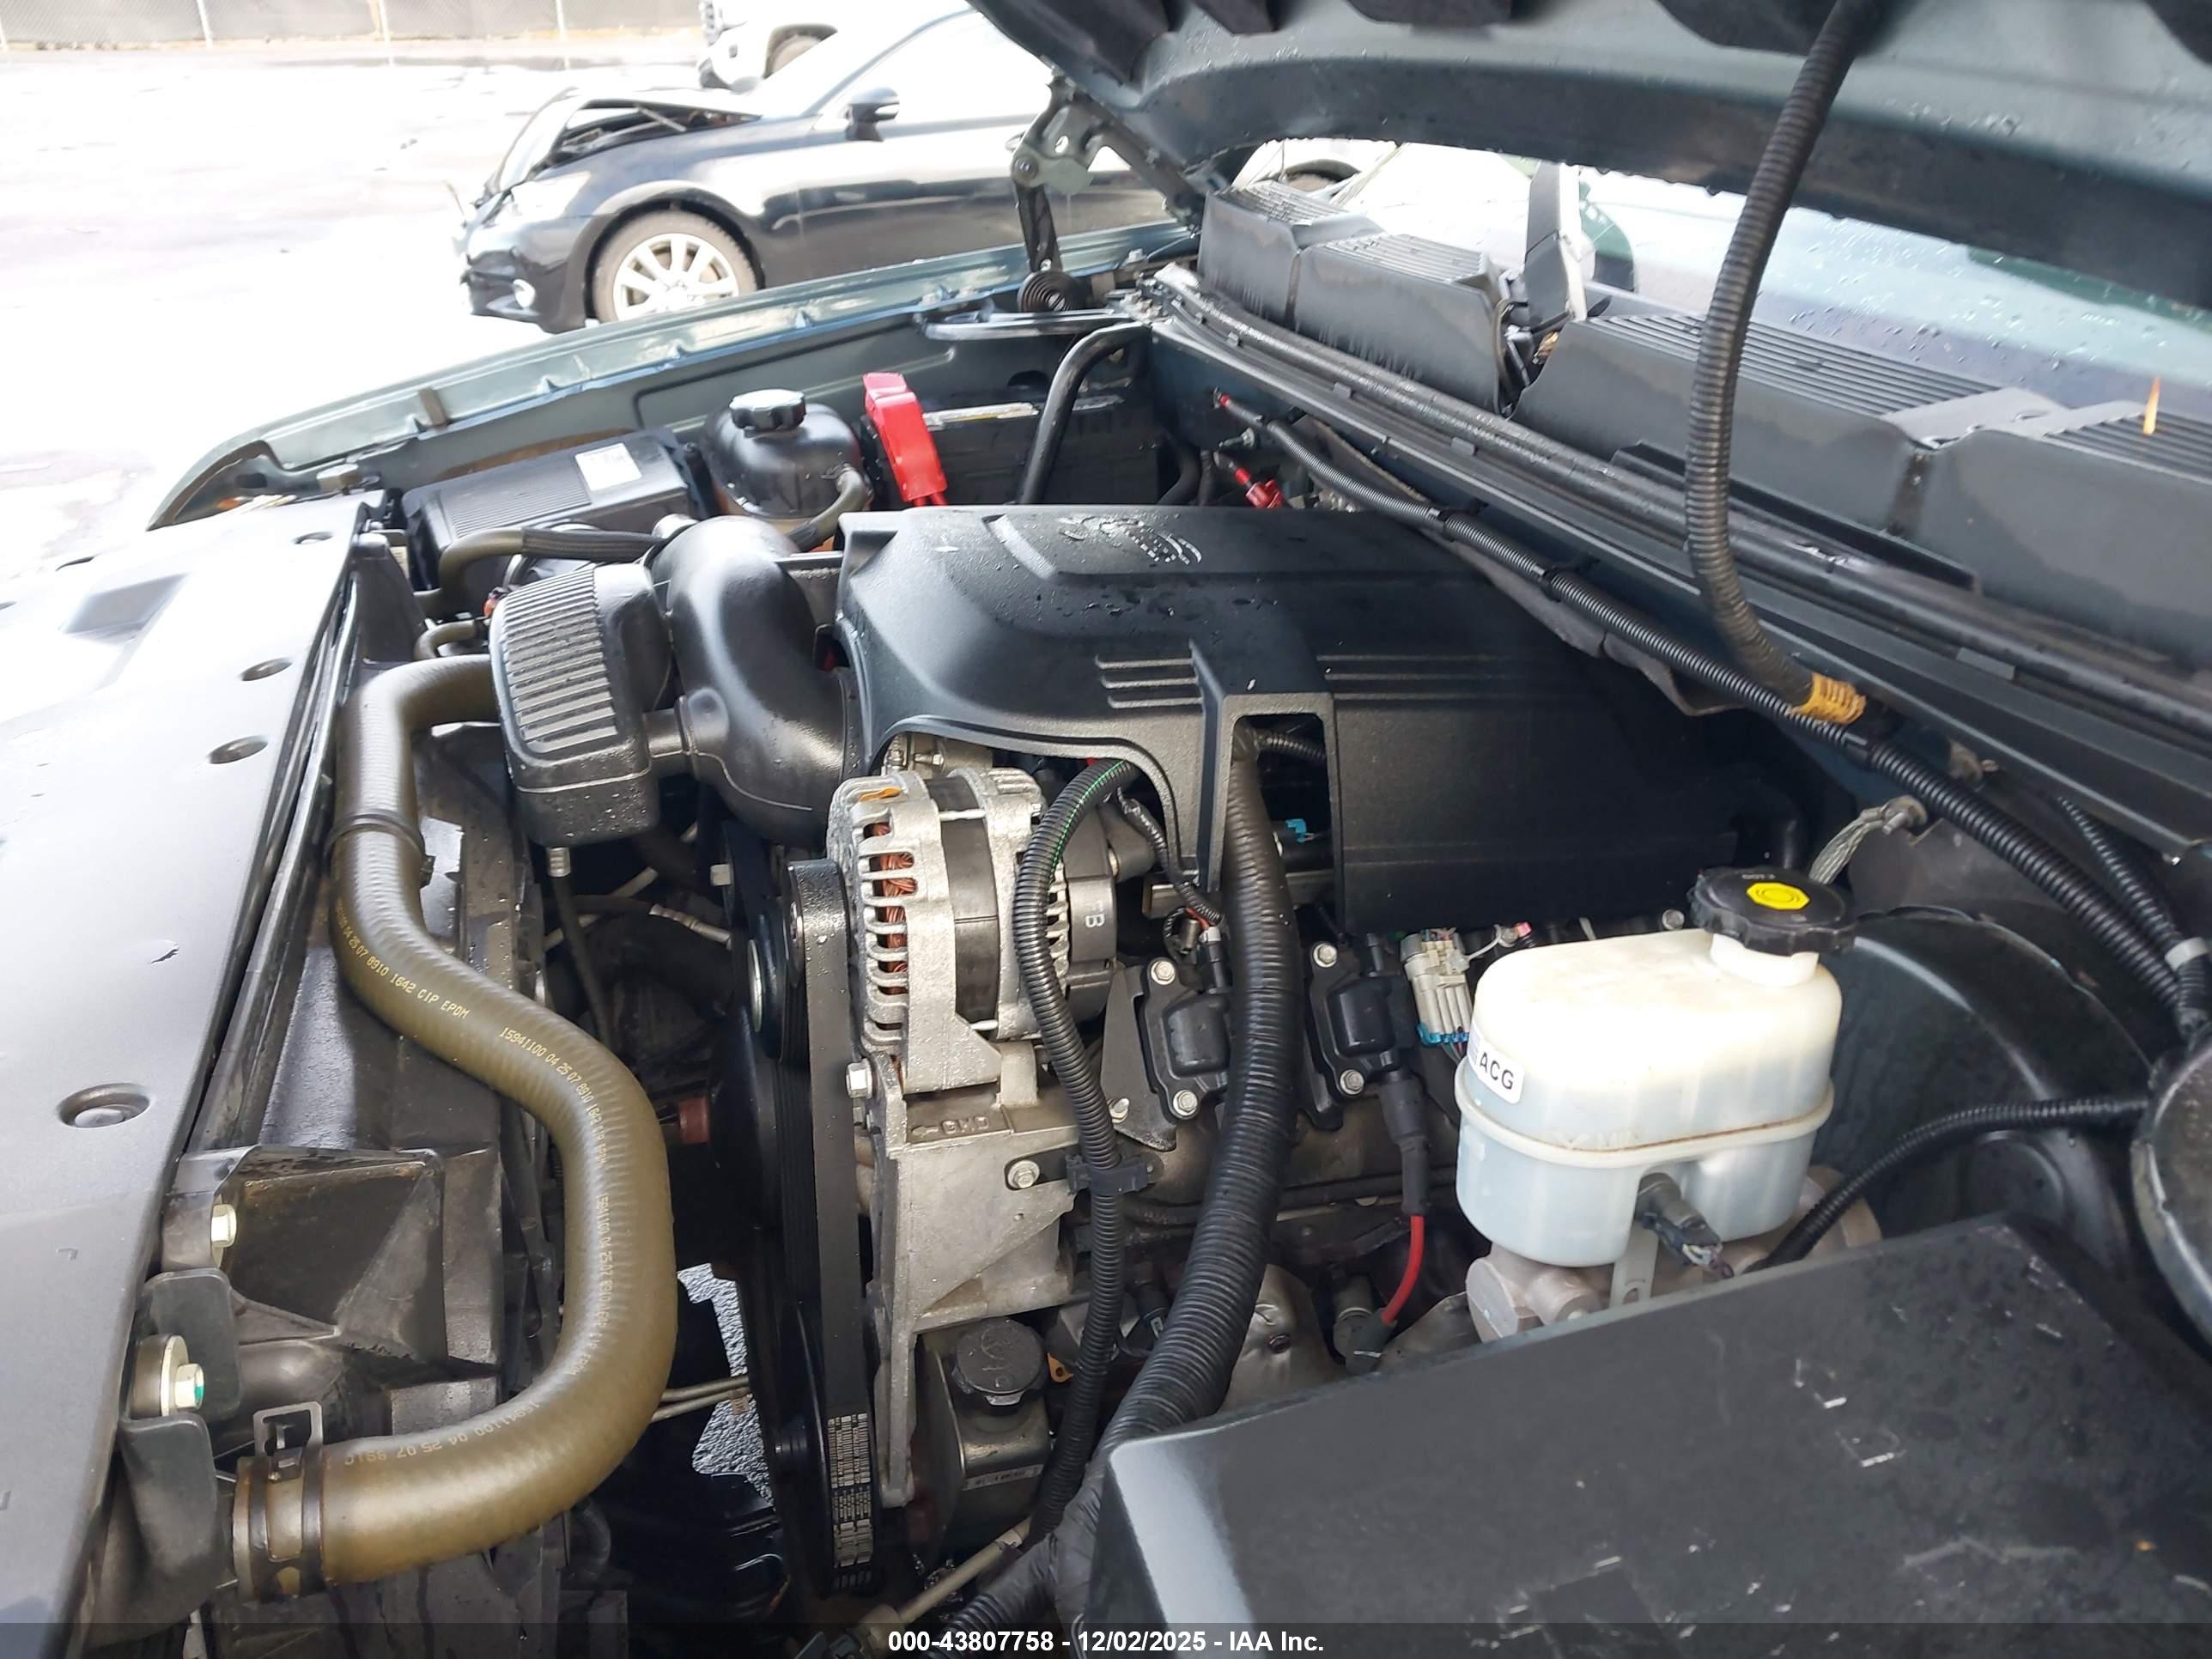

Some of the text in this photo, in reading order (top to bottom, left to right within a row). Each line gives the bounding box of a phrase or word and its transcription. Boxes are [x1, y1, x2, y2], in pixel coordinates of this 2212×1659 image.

[356, 945, 369, 958] 07
[366, 956, 390, 976] 8910
[390, 973, 416, 994] 1642
[416, 989, 441, 1004] CIP
[440, 1000, 471, 1019] EPDM
[499, 1027, 548, 1057] 15941100
[544, 1053, 561, 1066] 04
[556, 1062, 573, 1076] 25
[567, 1072, 582, 1085] 07
[575, 1083, 595, 1103] 8910
[1480, 1051, 1515, 1091] ACG
[396, 1444, 417, 1459] 07
[420, 1439, 443, 1454] 25
